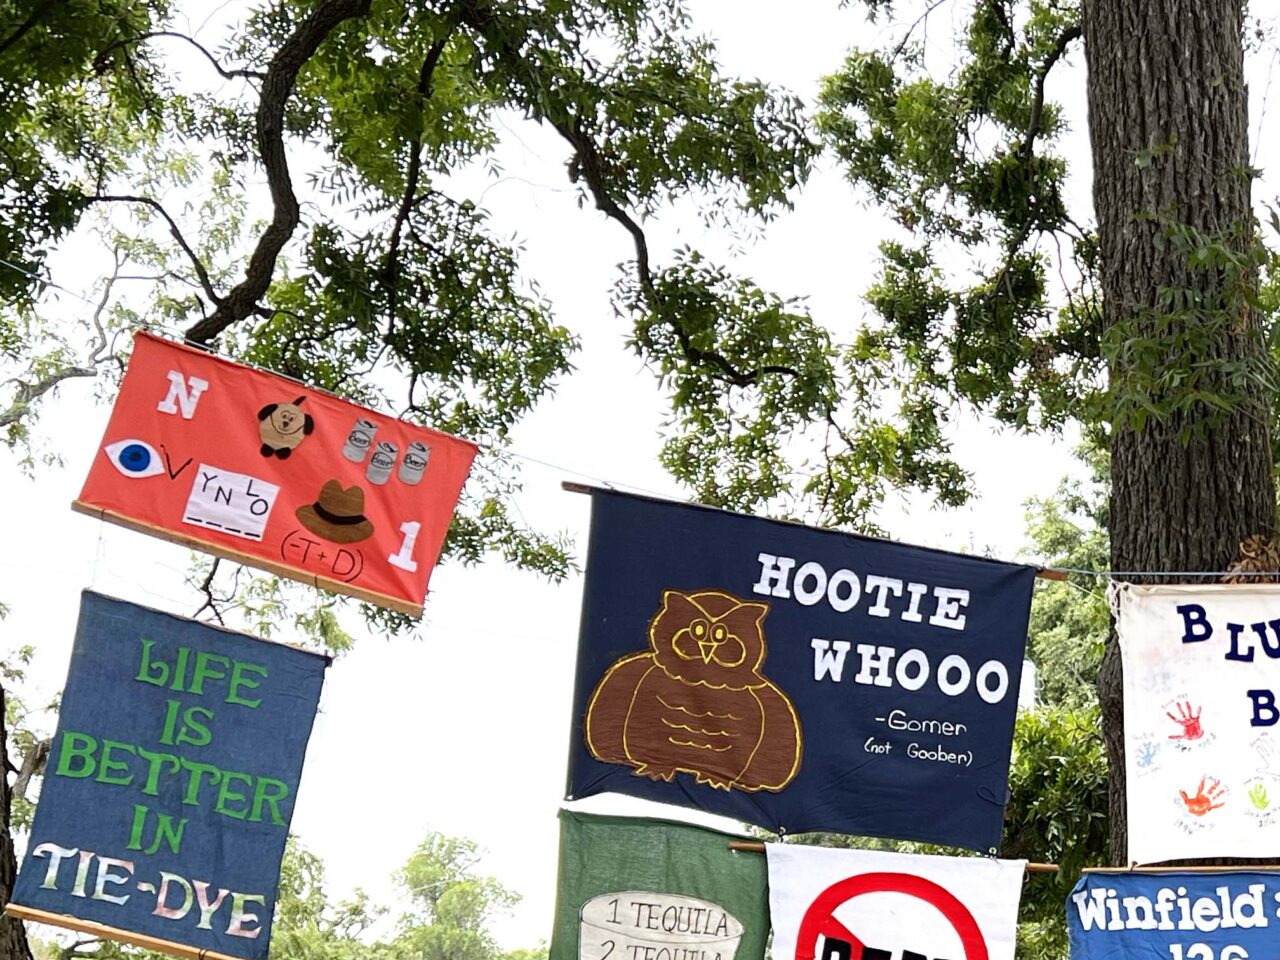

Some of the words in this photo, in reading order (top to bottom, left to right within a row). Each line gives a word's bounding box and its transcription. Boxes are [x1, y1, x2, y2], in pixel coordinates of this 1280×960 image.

[157, 370, 209, 420] N
[753, 553, 970, 630] HOOTIE
[134, 638, 268, 709] LIFE
[810, 638, 1009, 704] WHOOO
[159, 699, 215, 746] IS
[55, 730, 289, 827] BETTER
[126, 804, 189, 855] IN
[32, 842, 265, 940] TIE-DYE
[606, 898, 622, 925] 1
[631, 902, 729, 937] TEQUILA
